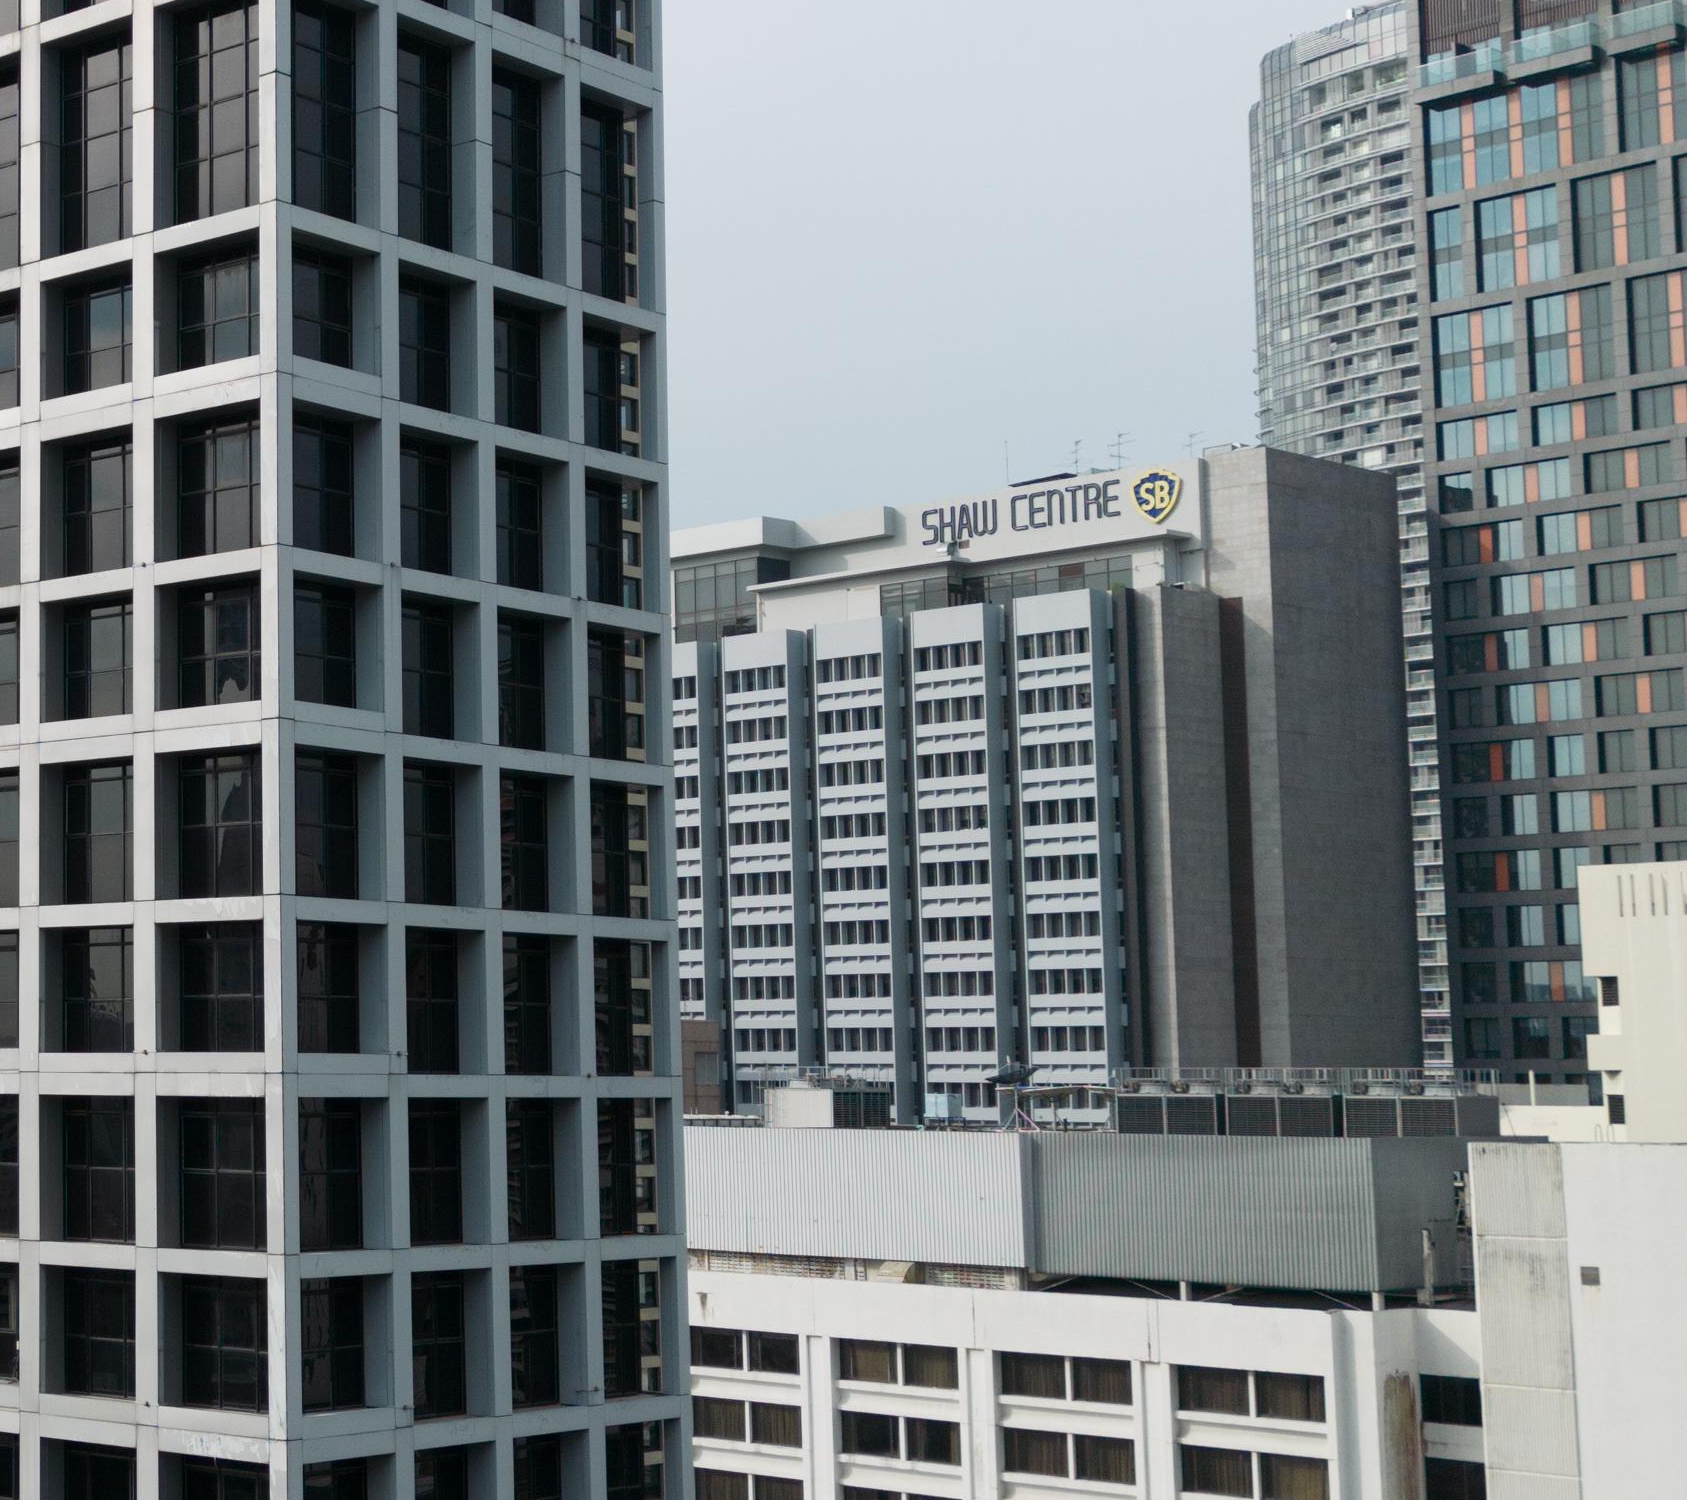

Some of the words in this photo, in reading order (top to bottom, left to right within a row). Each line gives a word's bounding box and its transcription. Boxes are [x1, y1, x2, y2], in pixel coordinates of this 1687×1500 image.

[921, 498, 998, 546] SHAW
[1010, 479, 1122, 532] CENTRE
[1139, 480, 1171, 511] SB
